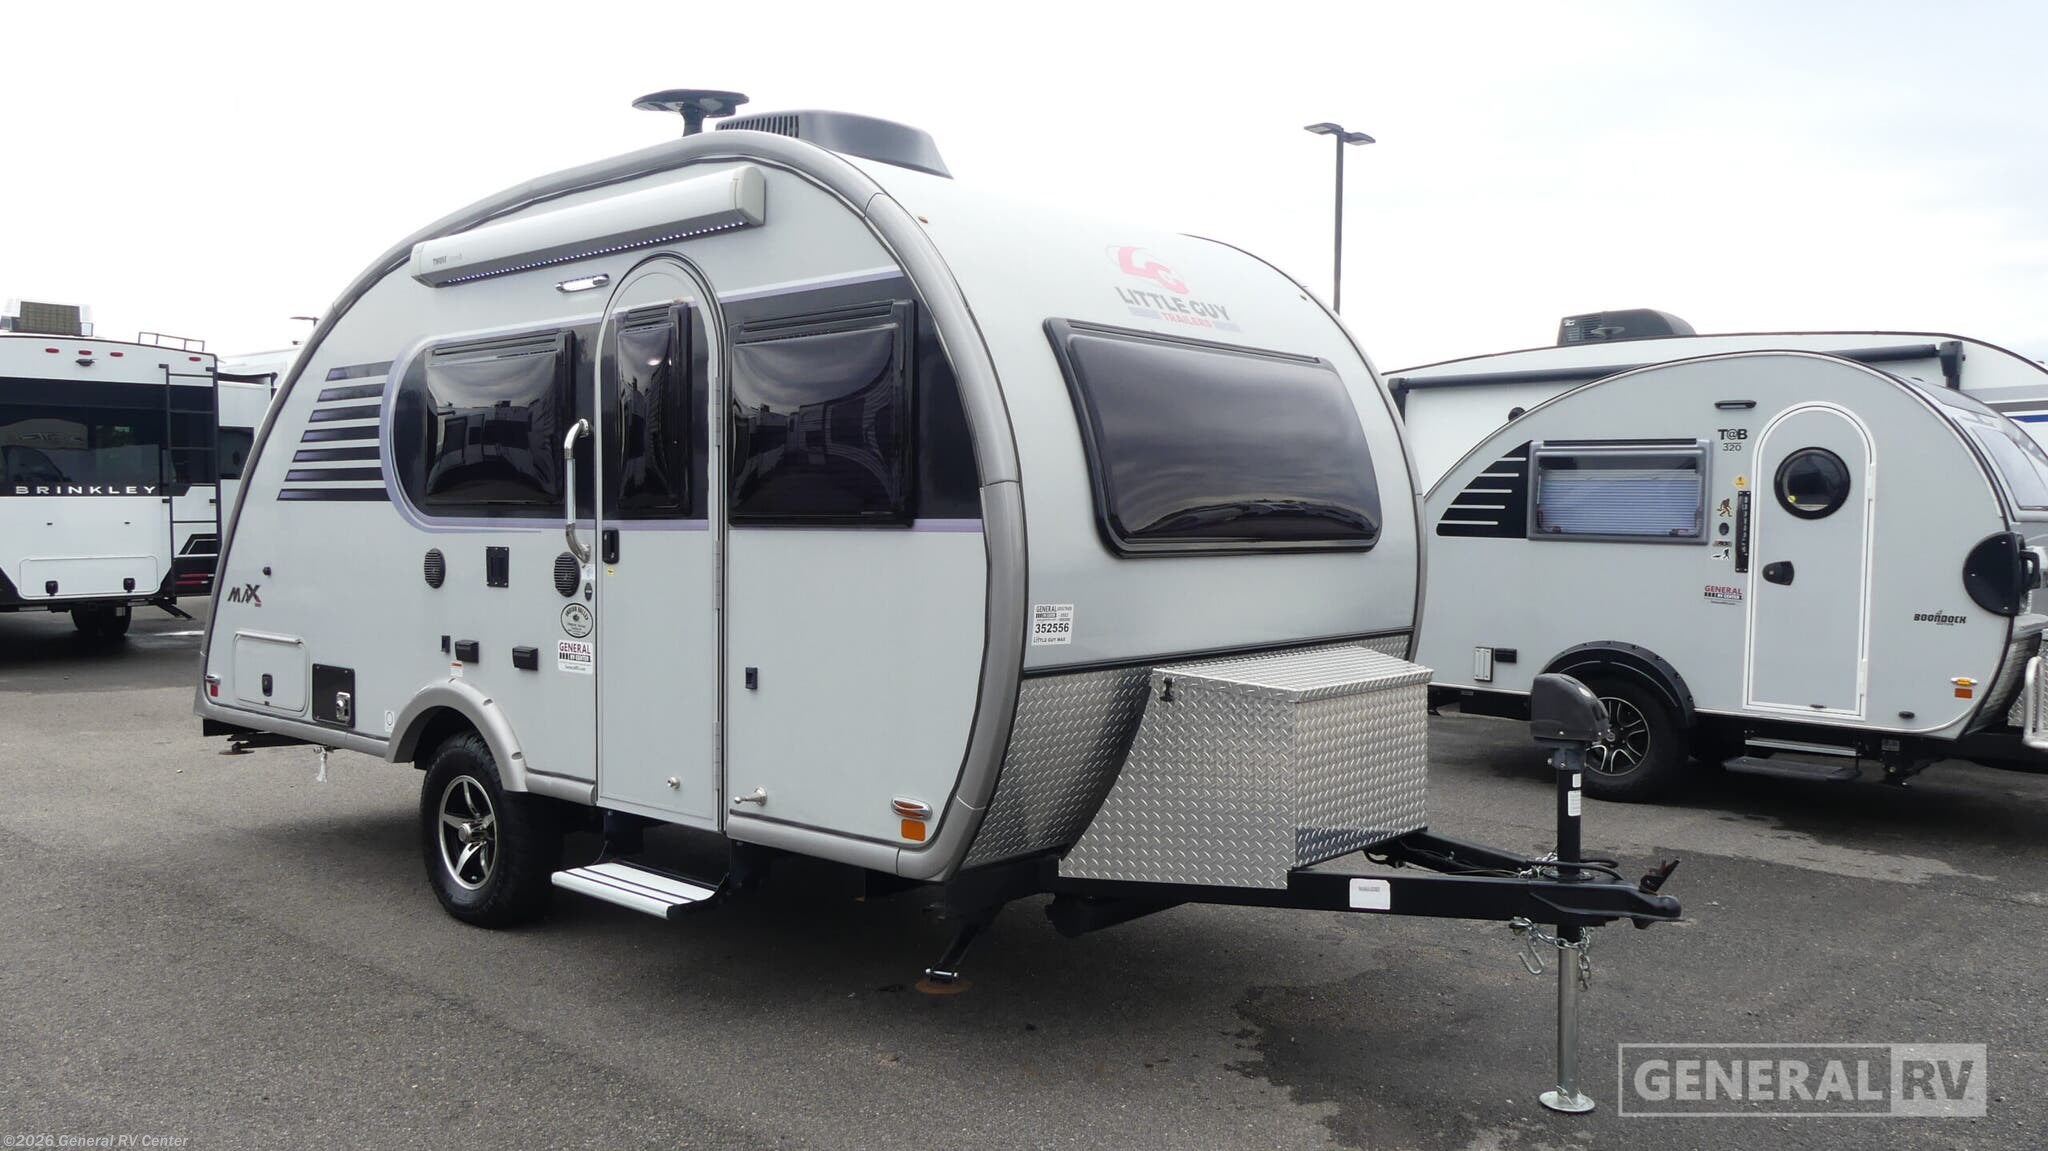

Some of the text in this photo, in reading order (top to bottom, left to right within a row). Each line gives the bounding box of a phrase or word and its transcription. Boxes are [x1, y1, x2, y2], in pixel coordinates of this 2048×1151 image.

[1114, 286, 1230, 320] LITTLE GUY
[1161, 312, 1212, 328] TRAILERS
[1717, 428, 1748, 440] T@B
[1722, 442, 1742, 451] 320
[15, 486, 156, 494] BRINKLEY
[1704, 585, 1743, 595] GENERAL
[1913, 613, 1967, 624] BOONDOCK
[1035, 622, 1070, 633] 352556
[559, 642, 591, 654] GENERAL
